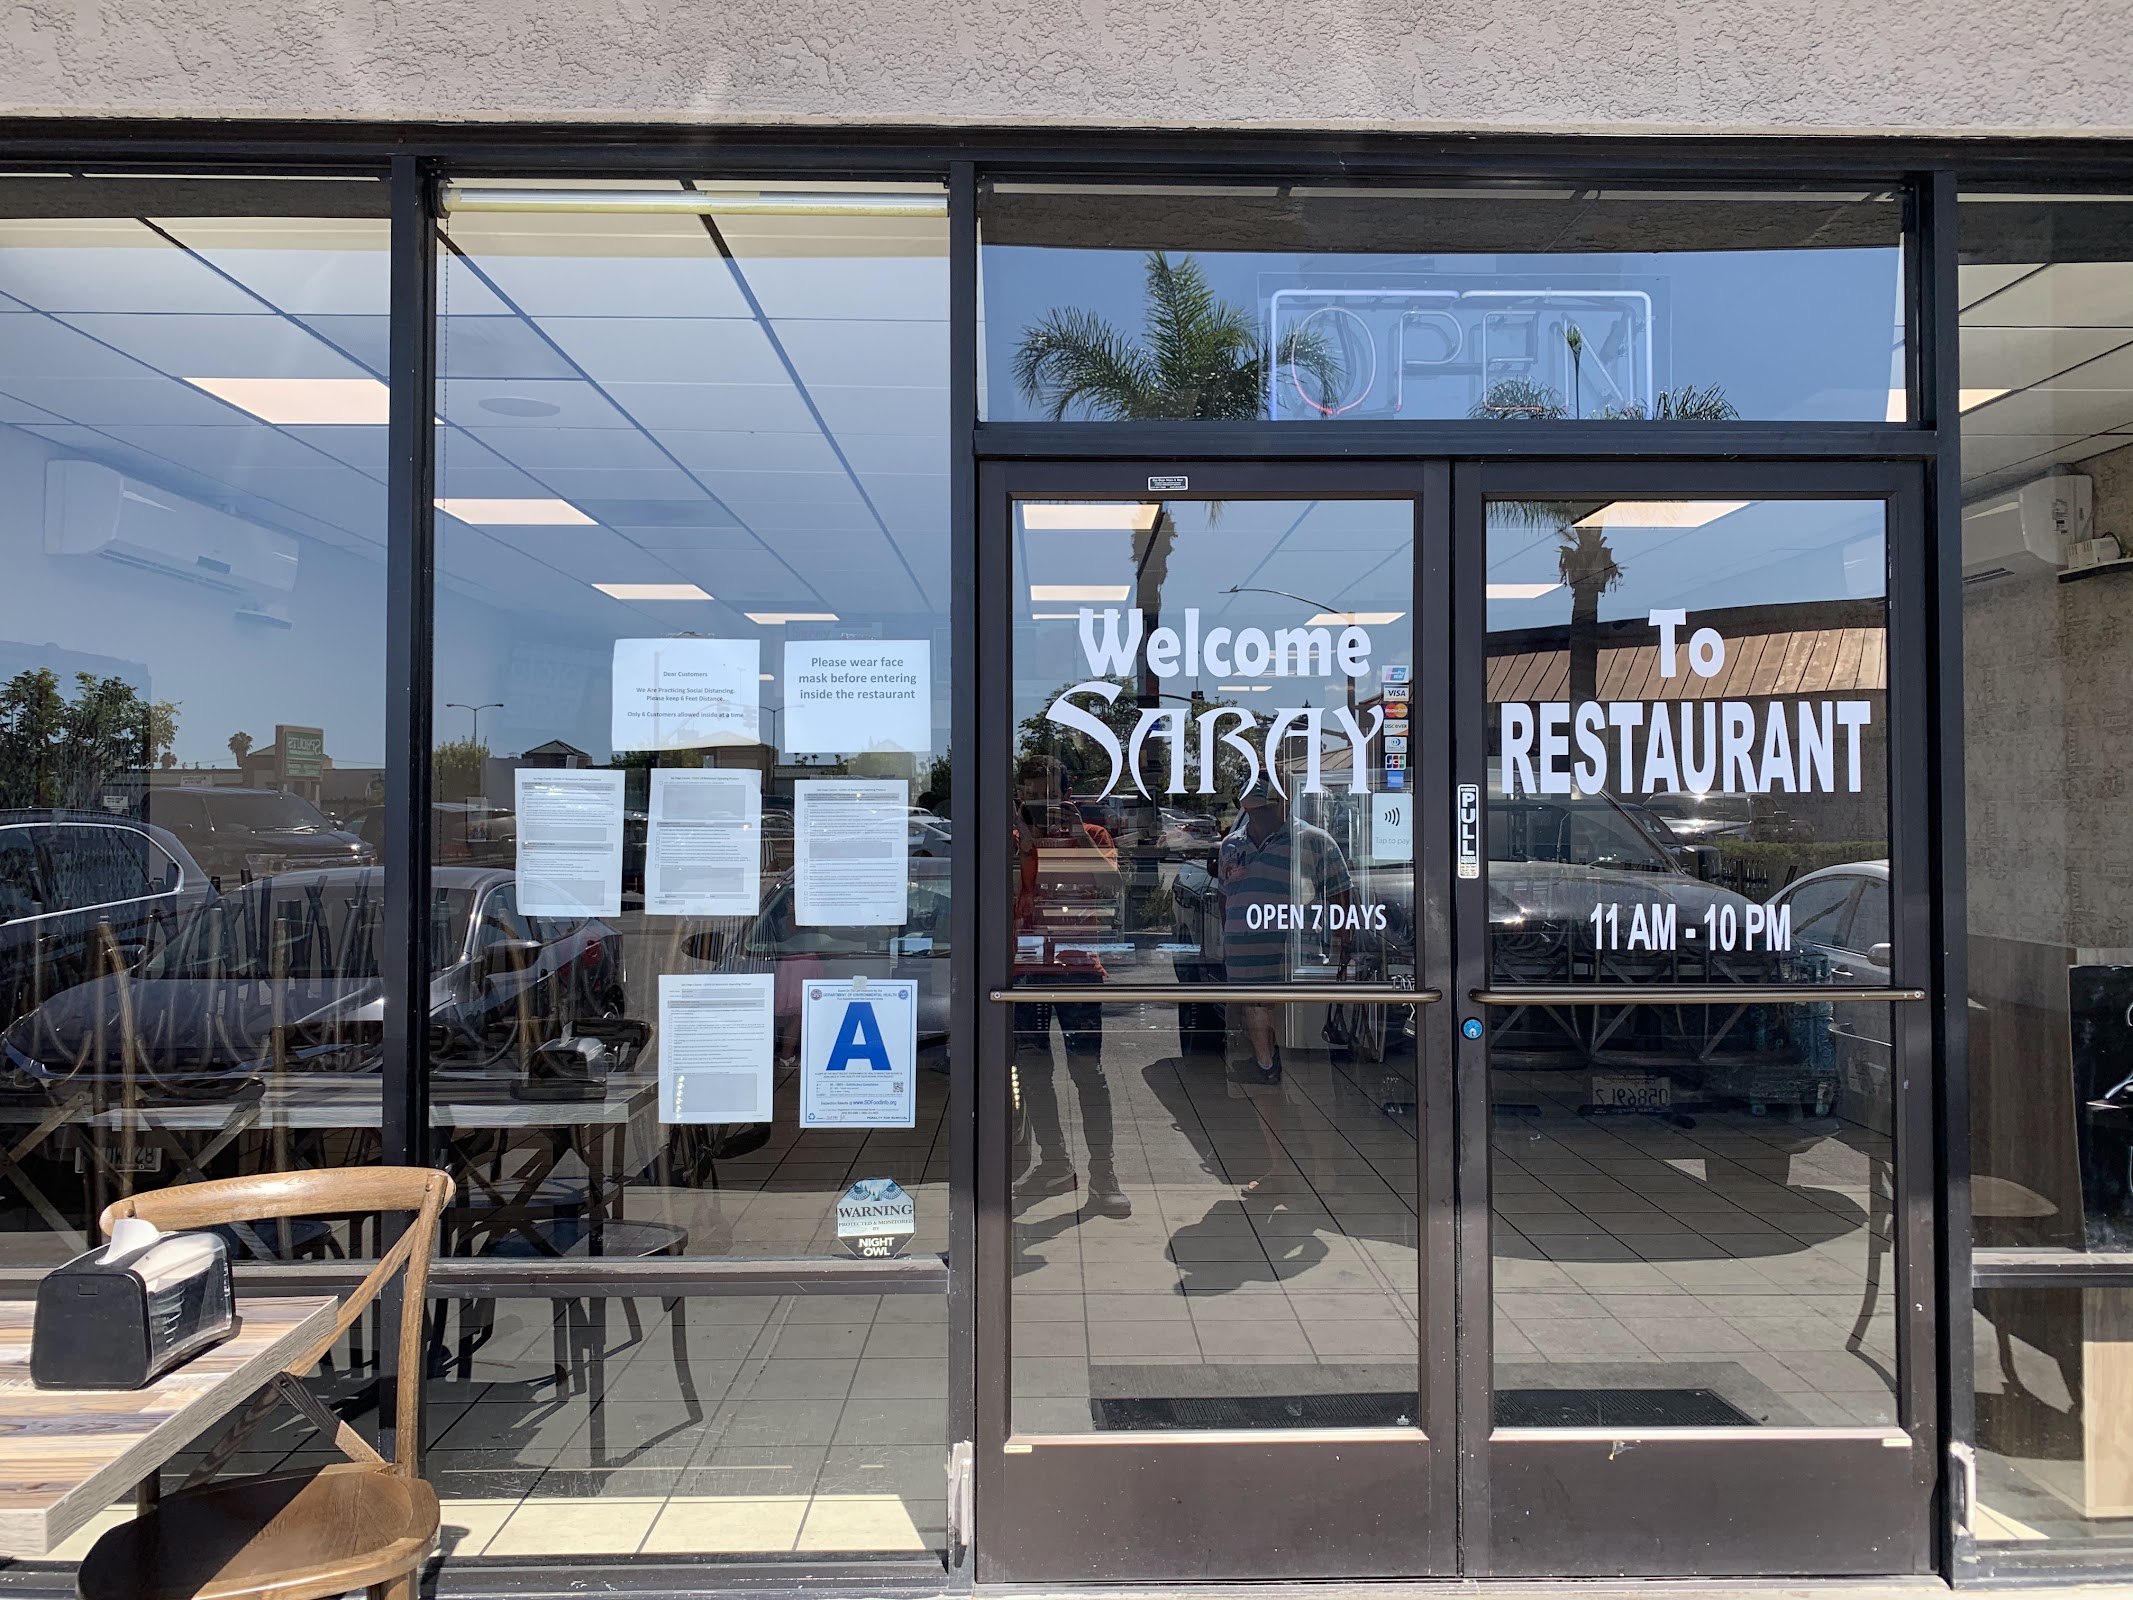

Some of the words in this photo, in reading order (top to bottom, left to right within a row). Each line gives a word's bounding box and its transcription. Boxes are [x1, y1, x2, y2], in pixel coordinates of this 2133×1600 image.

[1290, 306, 1634, 416] OPEN
[1079, 608, 1371, 678] Welcome
[1648, 608, 1725, 678] To
[811, 657, 847, 667] Please
[850, 659, 878, 667] wear
[881, 656, 904, 667] face
[798, 673, 828, 683] mask
[830, 673, 867, 683] before
[870, 673, 917, 685] entering
[658, 687, 686, 695] Practicing
[704, 687, 735, 695] Distancing.
[800, 689, 833, 699] inside
[836, 689, 855, 699] the
[857, 690, 916, 699] restaurant
[1388, 689, 1406, 697] VISA
[665, 695, 680, 703] keep
[1500, 701, 1871, 795] RESTAURANT
[1460, 792, 1476, 856] PULL
[1374, 837, 1387, 845] Tap
[1246, 903, 1304, 931] OPEN
[1311, 904, 1325, 930] 7
[1330, 903, 1387, 931] DAYS
[1589, 903, 1618, 951] 11
[1627, 904, 1676, 951] AM
[1685, 926, 1697, 939] -
[1702, 903, 1736, 951] 10
[1745, 904, 1791, 951] PM
[826, 1001, 892, 1071] A
[838, 1204, 913, 1218] WARNING
[858, 1237, 895, 1248] NIGHT
[863, 1247, 890, 1257] OWL
